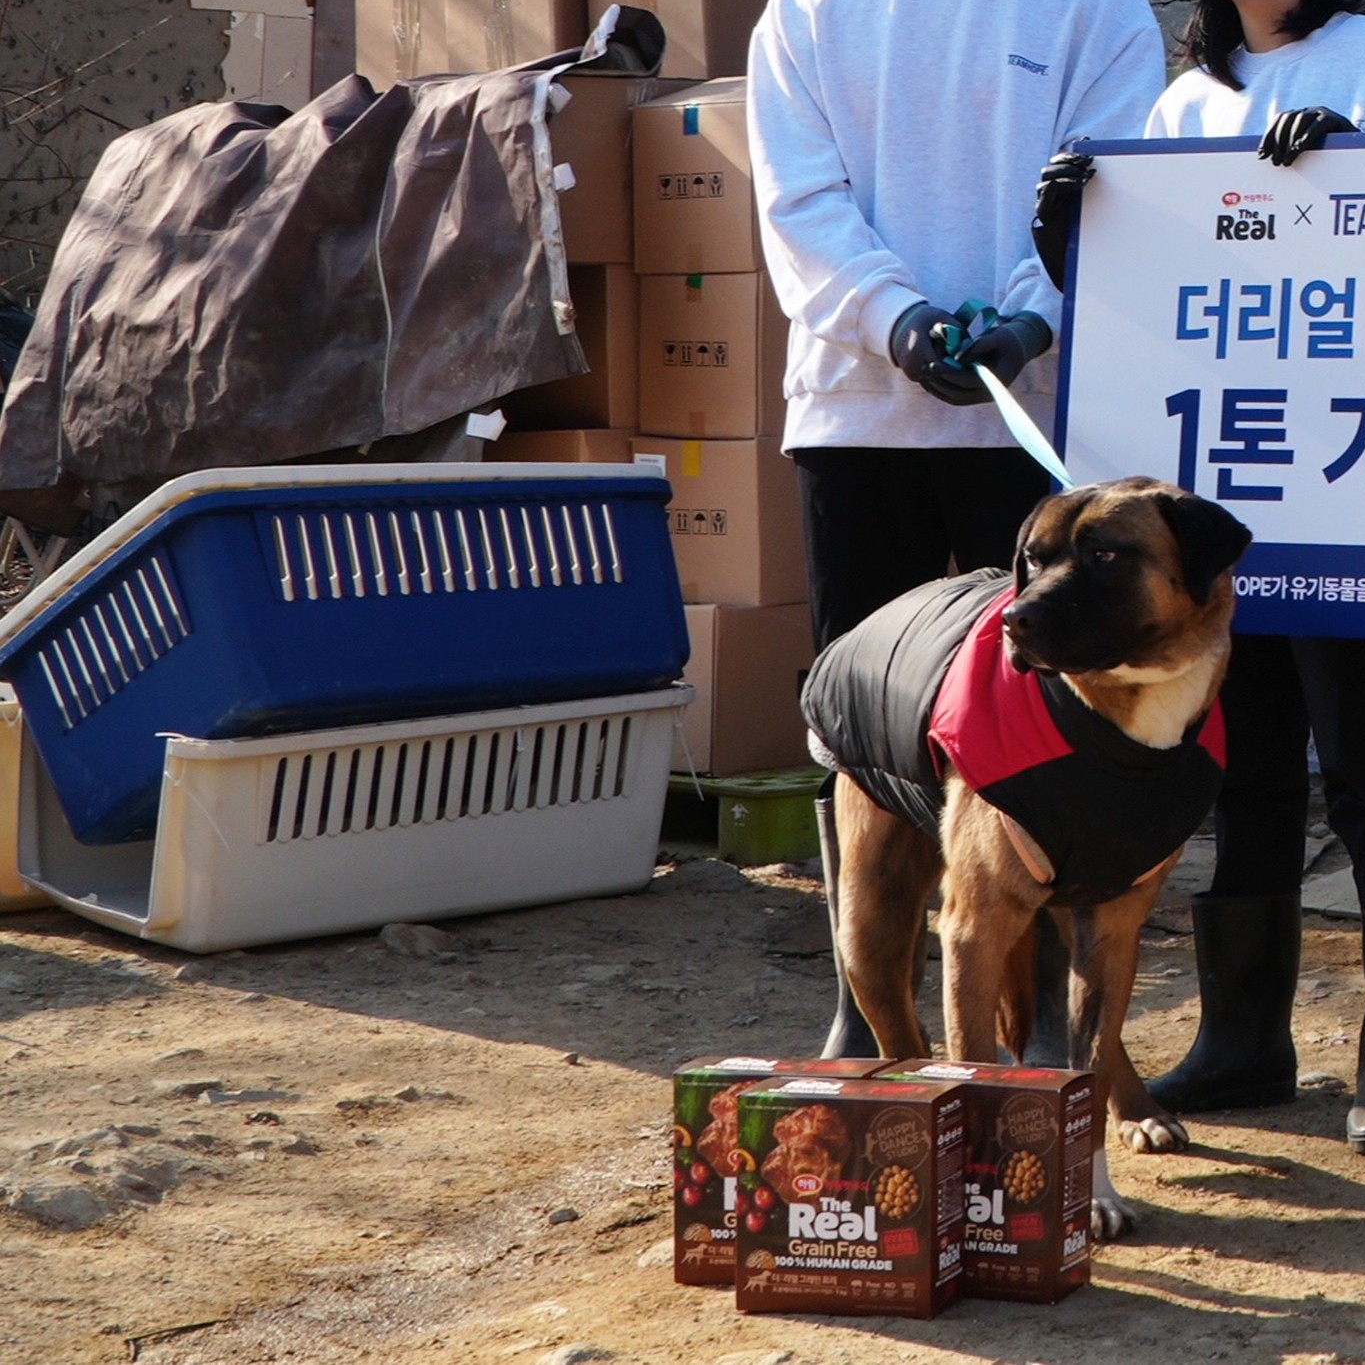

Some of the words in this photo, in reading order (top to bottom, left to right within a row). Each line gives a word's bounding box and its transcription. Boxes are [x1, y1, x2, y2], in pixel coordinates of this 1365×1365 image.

[1238, 209, 1259, 220] The
[1216, 214, 1276, 241] Real
[1175, 277, 1356, 360] 더리얼
[1165, 387, 1294, 502] 1톤
[877, 1121, 916, 1139] HAPPY
[879, 1135, 920, 1152] DANCE
[886, 1145, 919, 1161] STUDIO
[820, 1197, 852, 1213] The
[789, 1203, 878, 1242] Real
[788, 1240, 835, 1257] Grain
[838, 1243, 877, 1259] Free
[806, 1257, 850, 1270] HUMAN
[852, 1259, 893, 1271] GRADE
